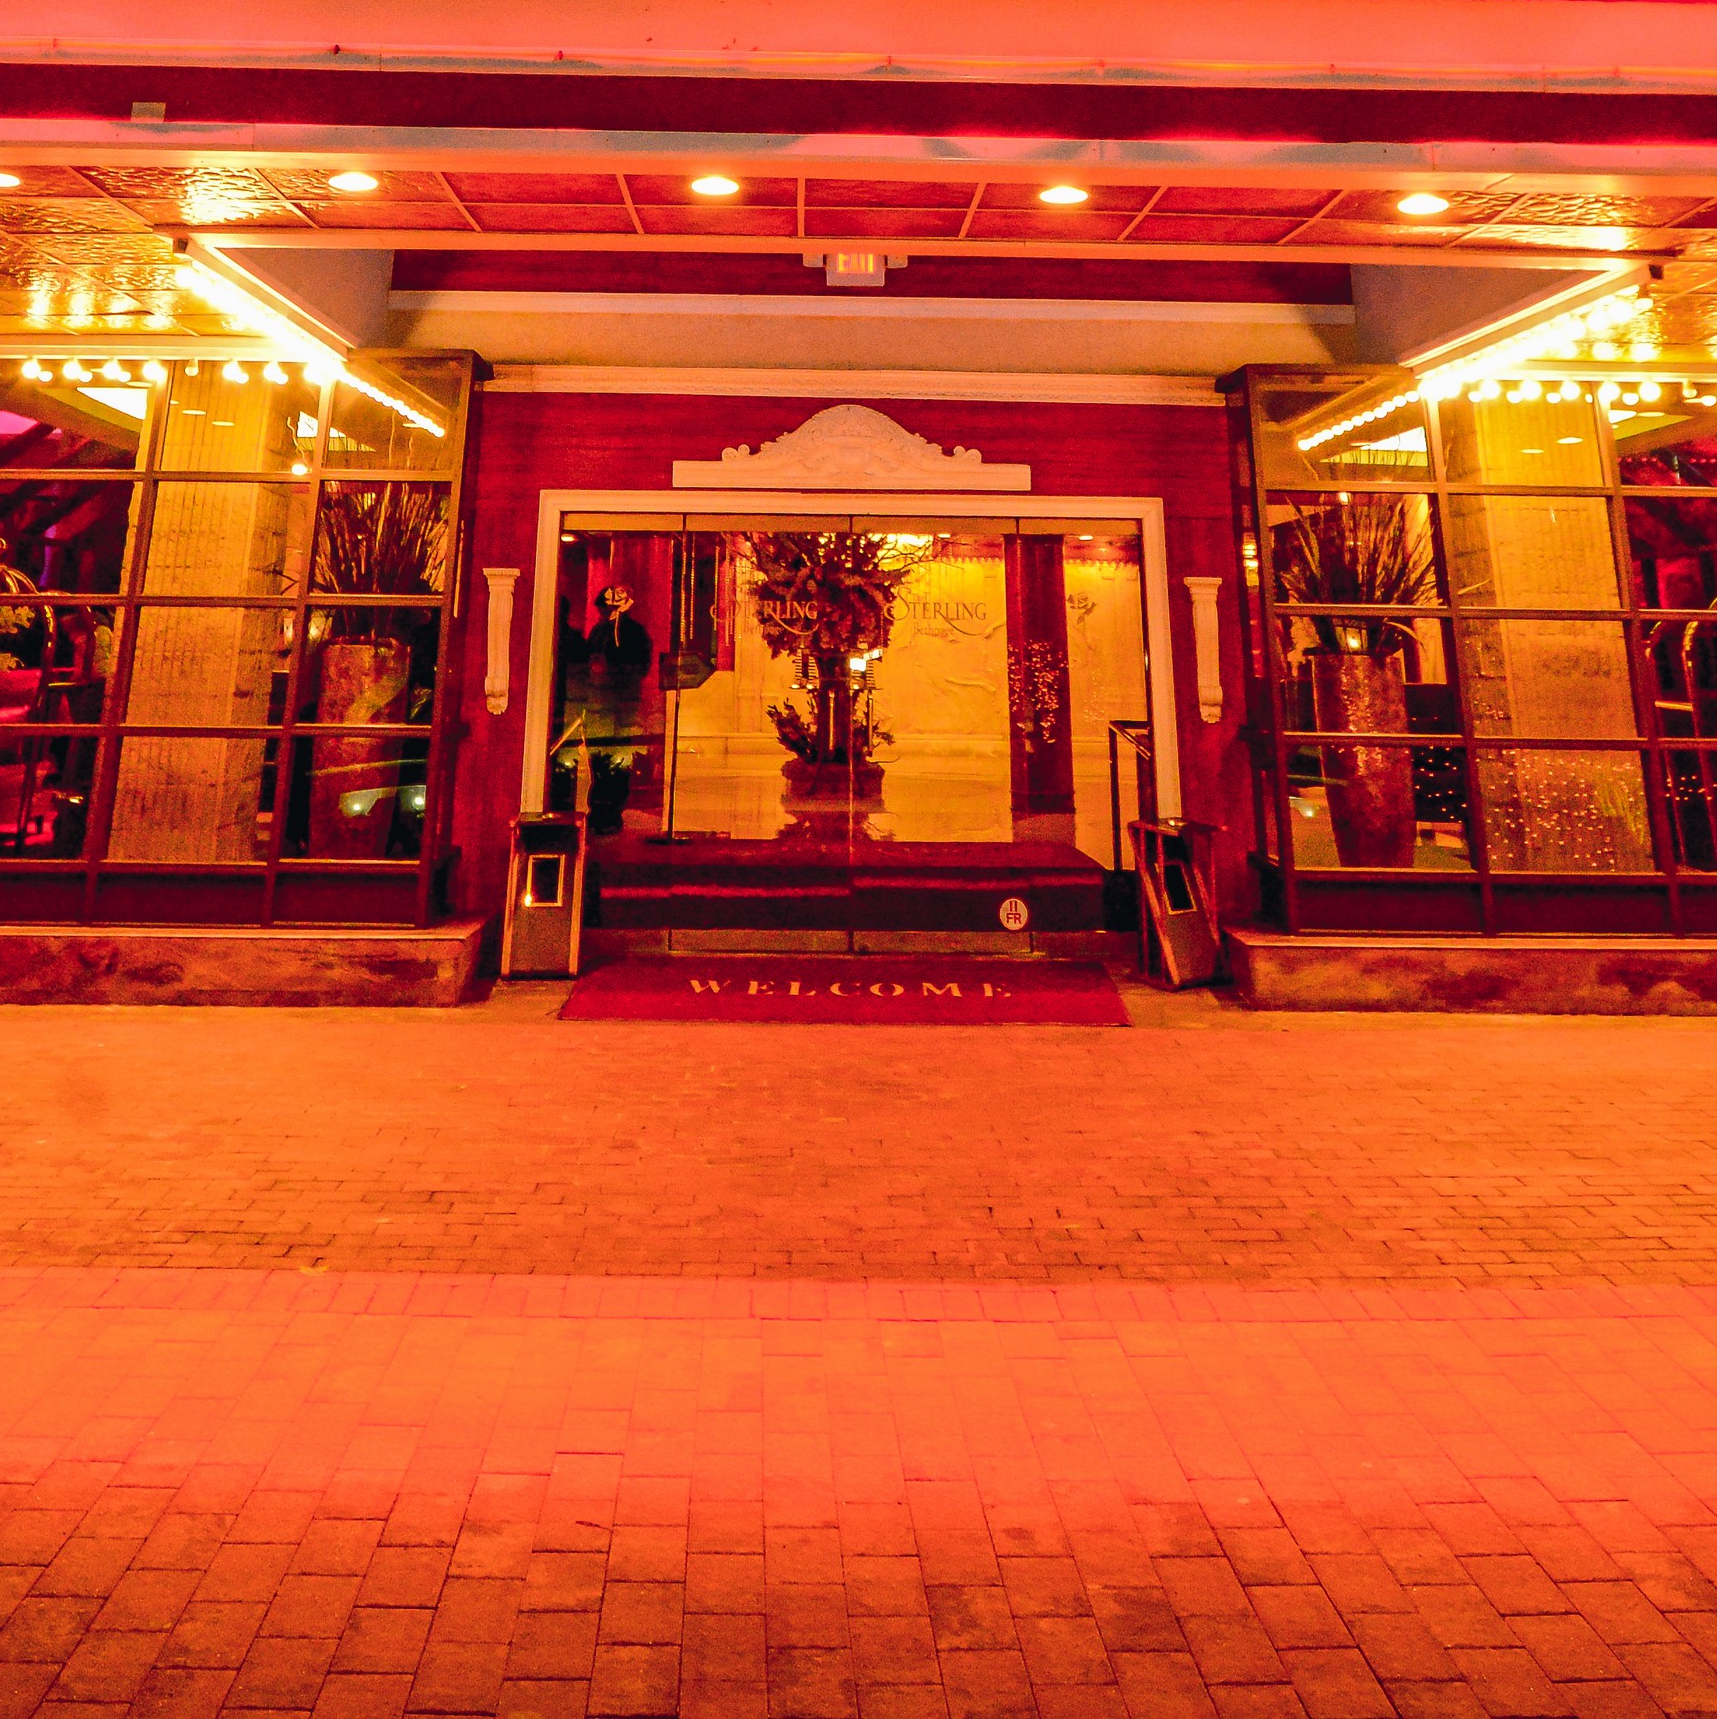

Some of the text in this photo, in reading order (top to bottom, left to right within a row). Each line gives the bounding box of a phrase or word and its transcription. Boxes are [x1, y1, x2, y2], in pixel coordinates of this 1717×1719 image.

[709, 587, 820, 636] SRLING
[883, 586, 987, 636] STERLING
[1006, 912, 1022, 925] FR
[689, 979, 1012, 998] WELCOME
